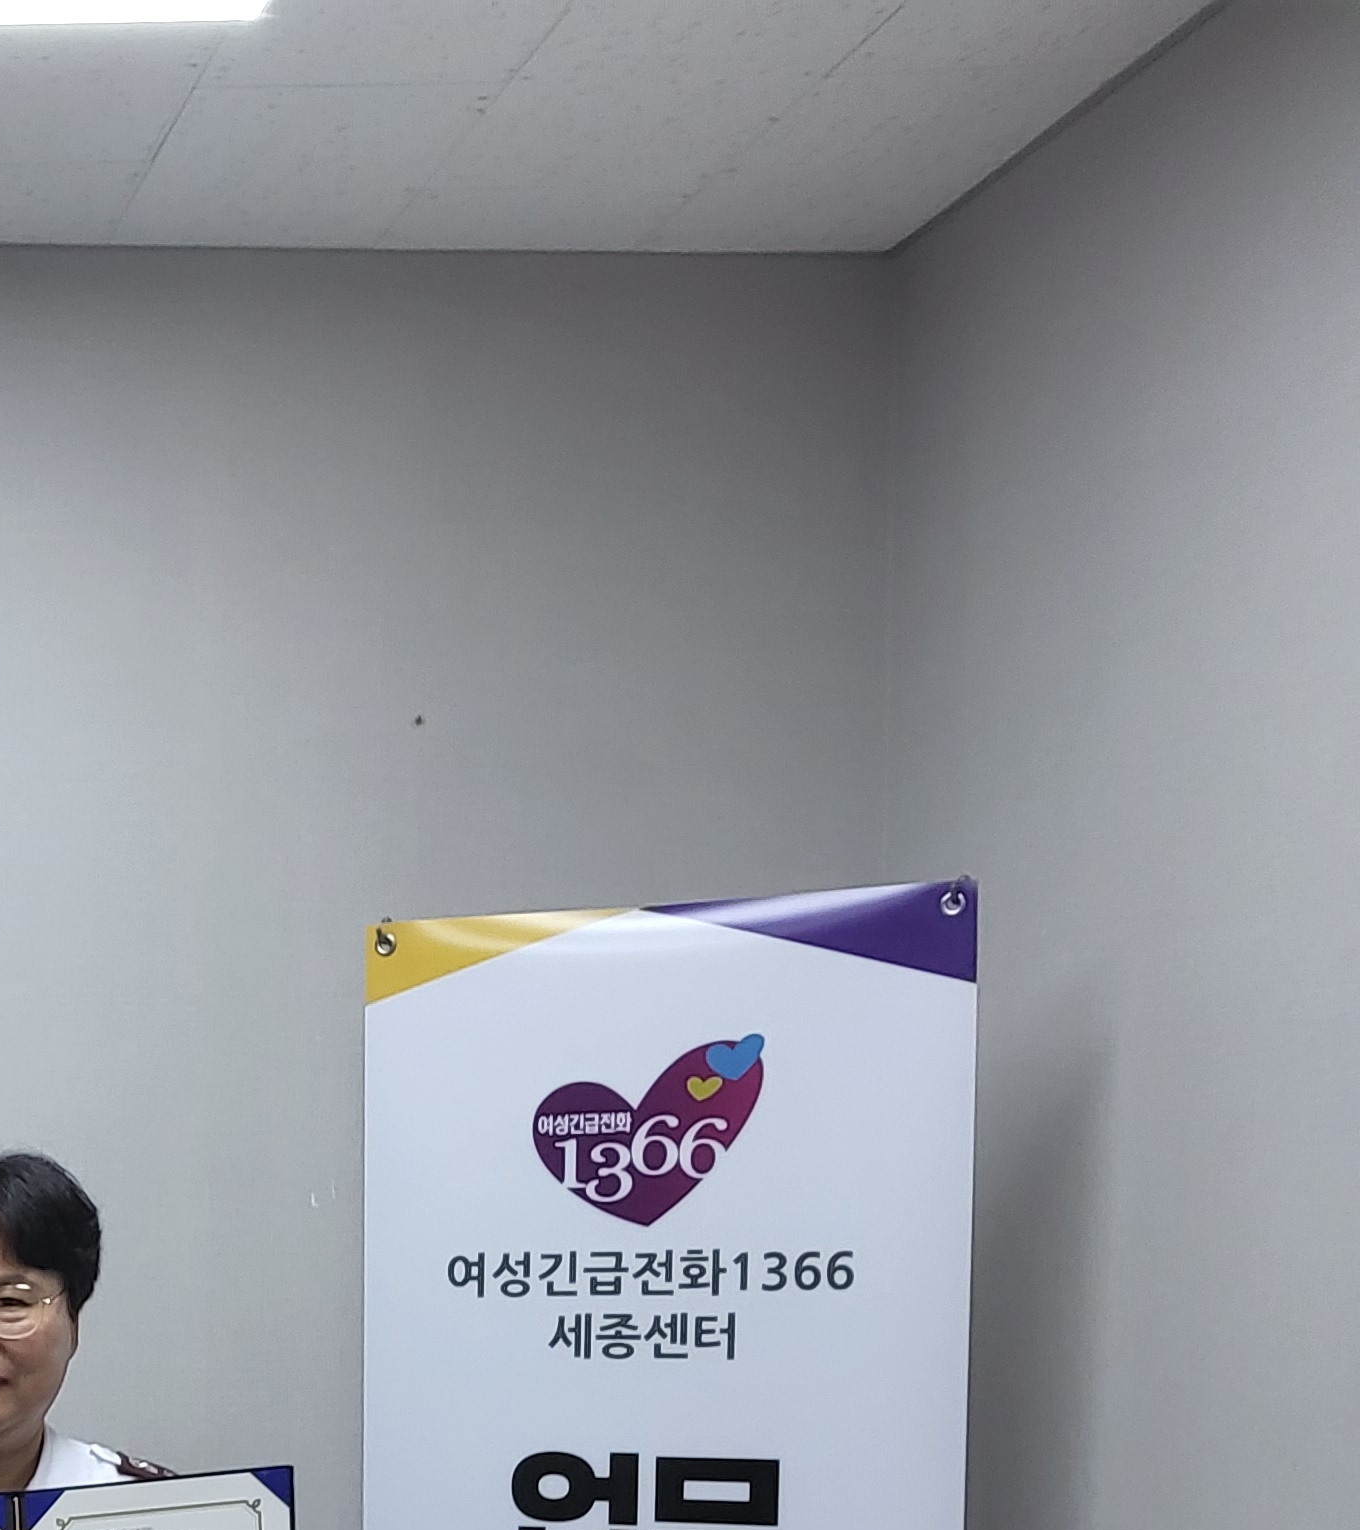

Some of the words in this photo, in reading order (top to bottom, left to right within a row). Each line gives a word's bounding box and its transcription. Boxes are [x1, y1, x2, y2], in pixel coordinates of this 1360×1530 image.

[537, 1112, 633, 1135] 여성긴급전화
[552, 1115, 728, 1203] 1366
[446, 1247, 856, 1299] 여성긴급전화1366
[547, 1312, 739, 1362] 세종센터
